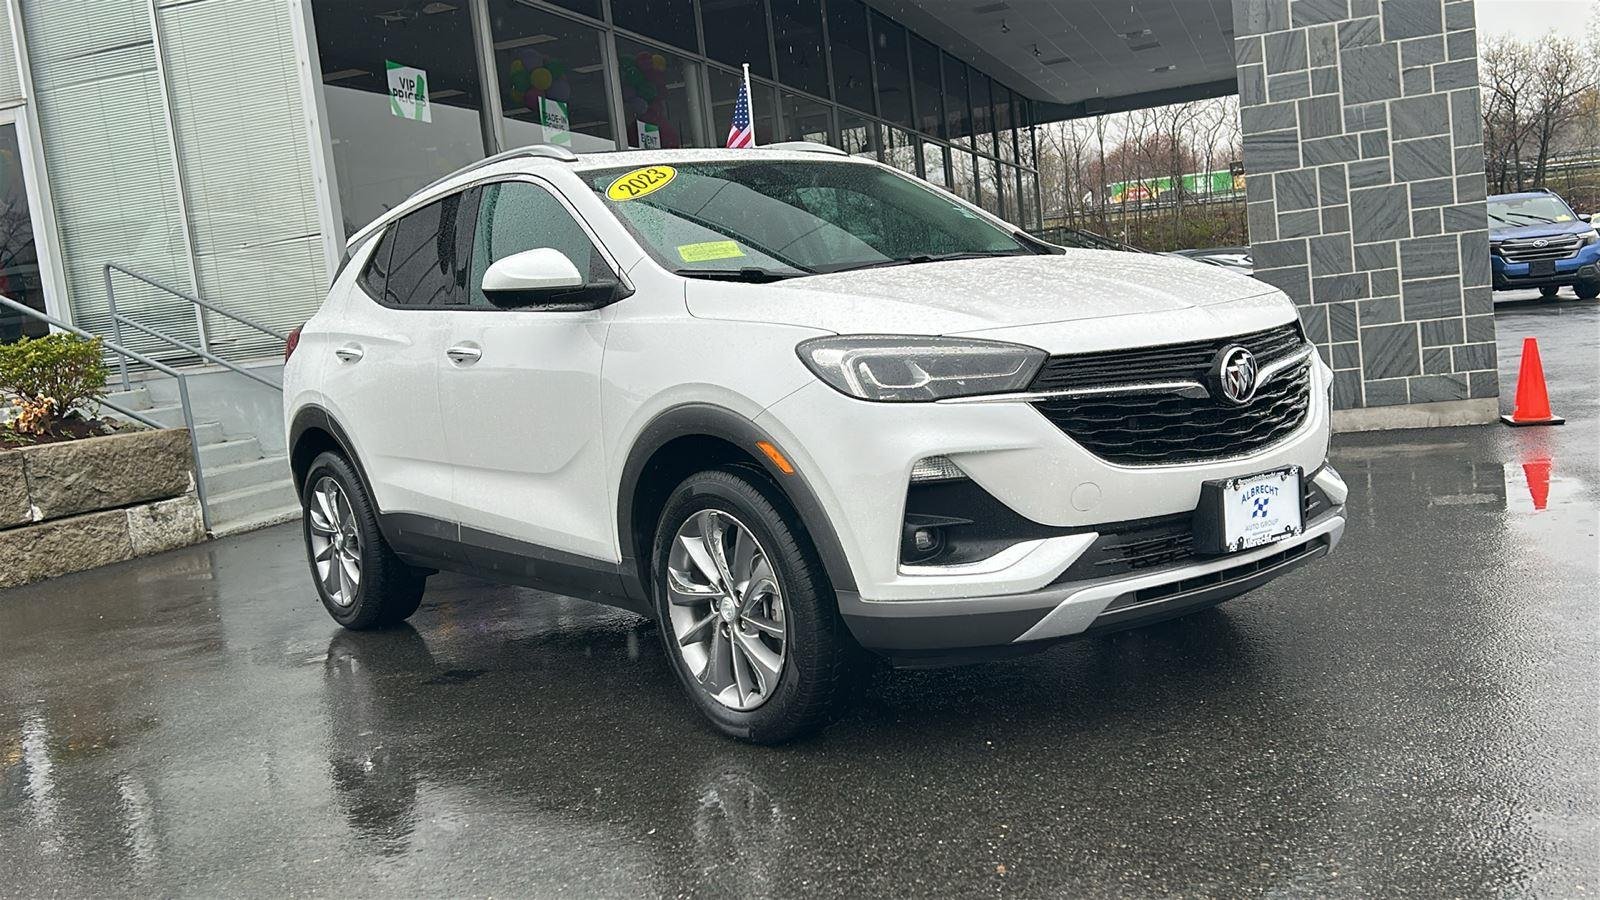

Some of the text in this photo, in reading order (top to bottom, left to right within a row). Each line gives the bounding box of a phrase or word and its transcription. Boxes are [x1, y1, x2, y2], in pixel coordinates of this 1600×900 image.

[398, 76, 416, 92] VIP
[392, 87, 427, 107] PRICES
[618, 168, 667, 196] 2023
[1241, 484, 1280, 504] ALBRECHT
[1245, 522, 1260, 531] AUTO
